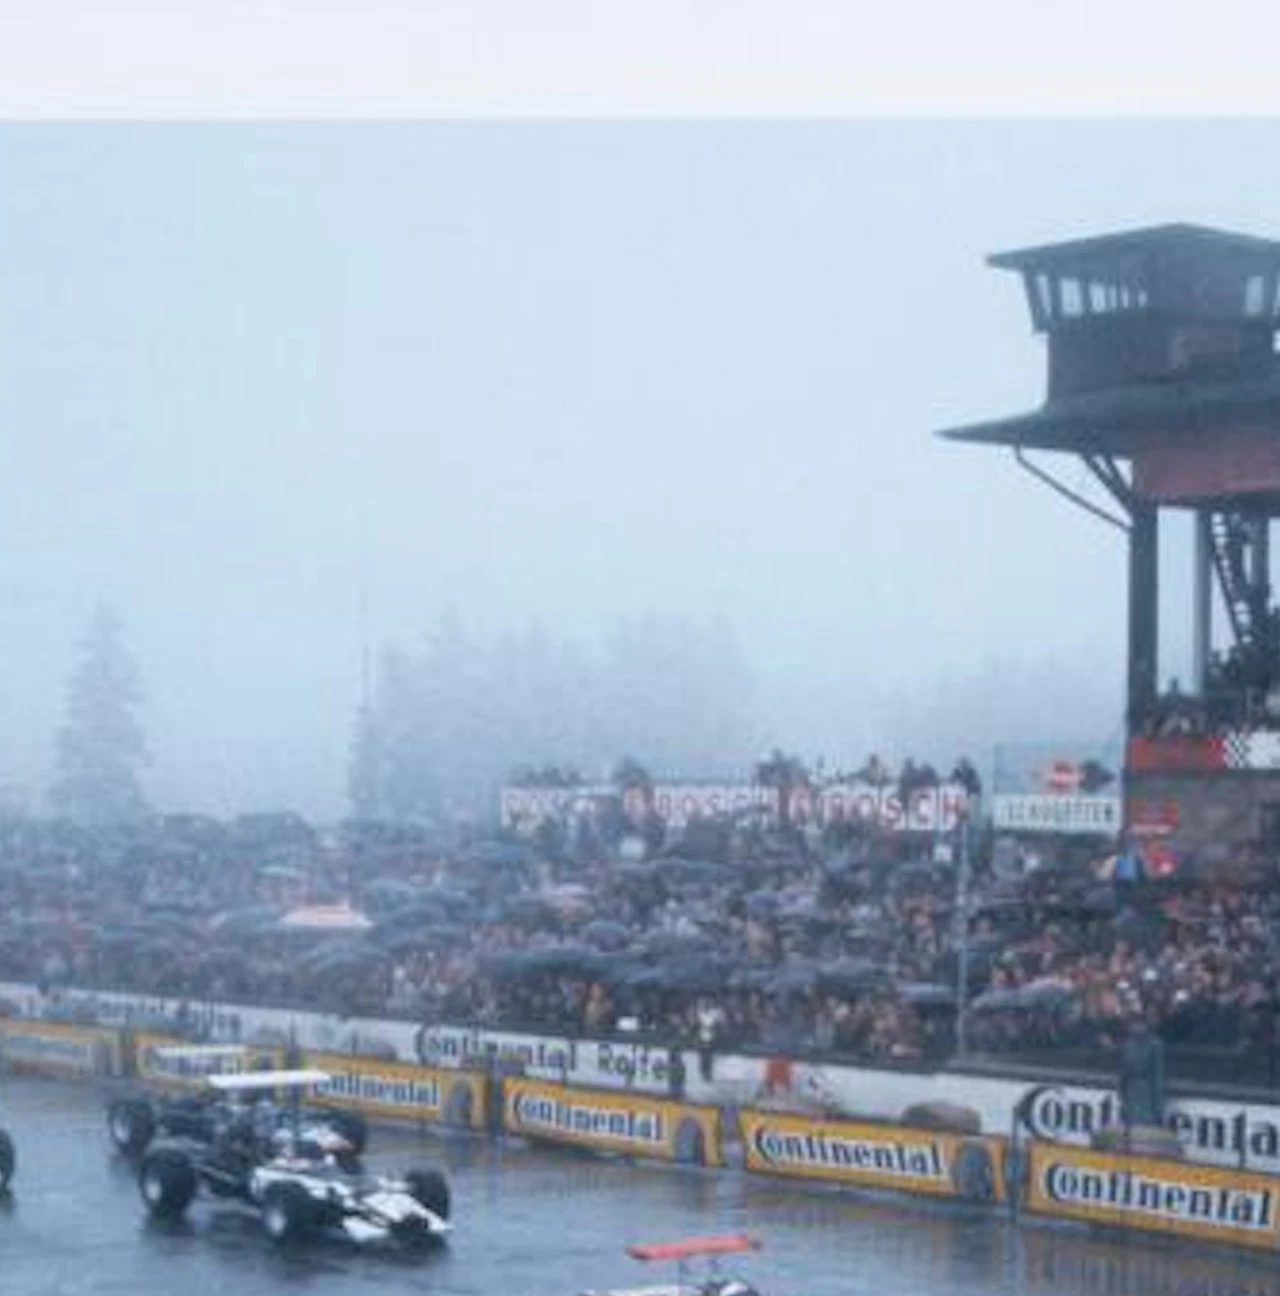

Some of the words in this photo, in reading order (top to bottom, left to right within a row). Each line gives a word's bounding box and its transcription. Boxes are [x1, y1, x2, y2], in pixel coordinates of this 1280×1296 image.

[514, 1094, 663, 1141] Continental
[753, 1125, 942, 1177] Continental
[1045, 1163, 1272, 1226] Continental
